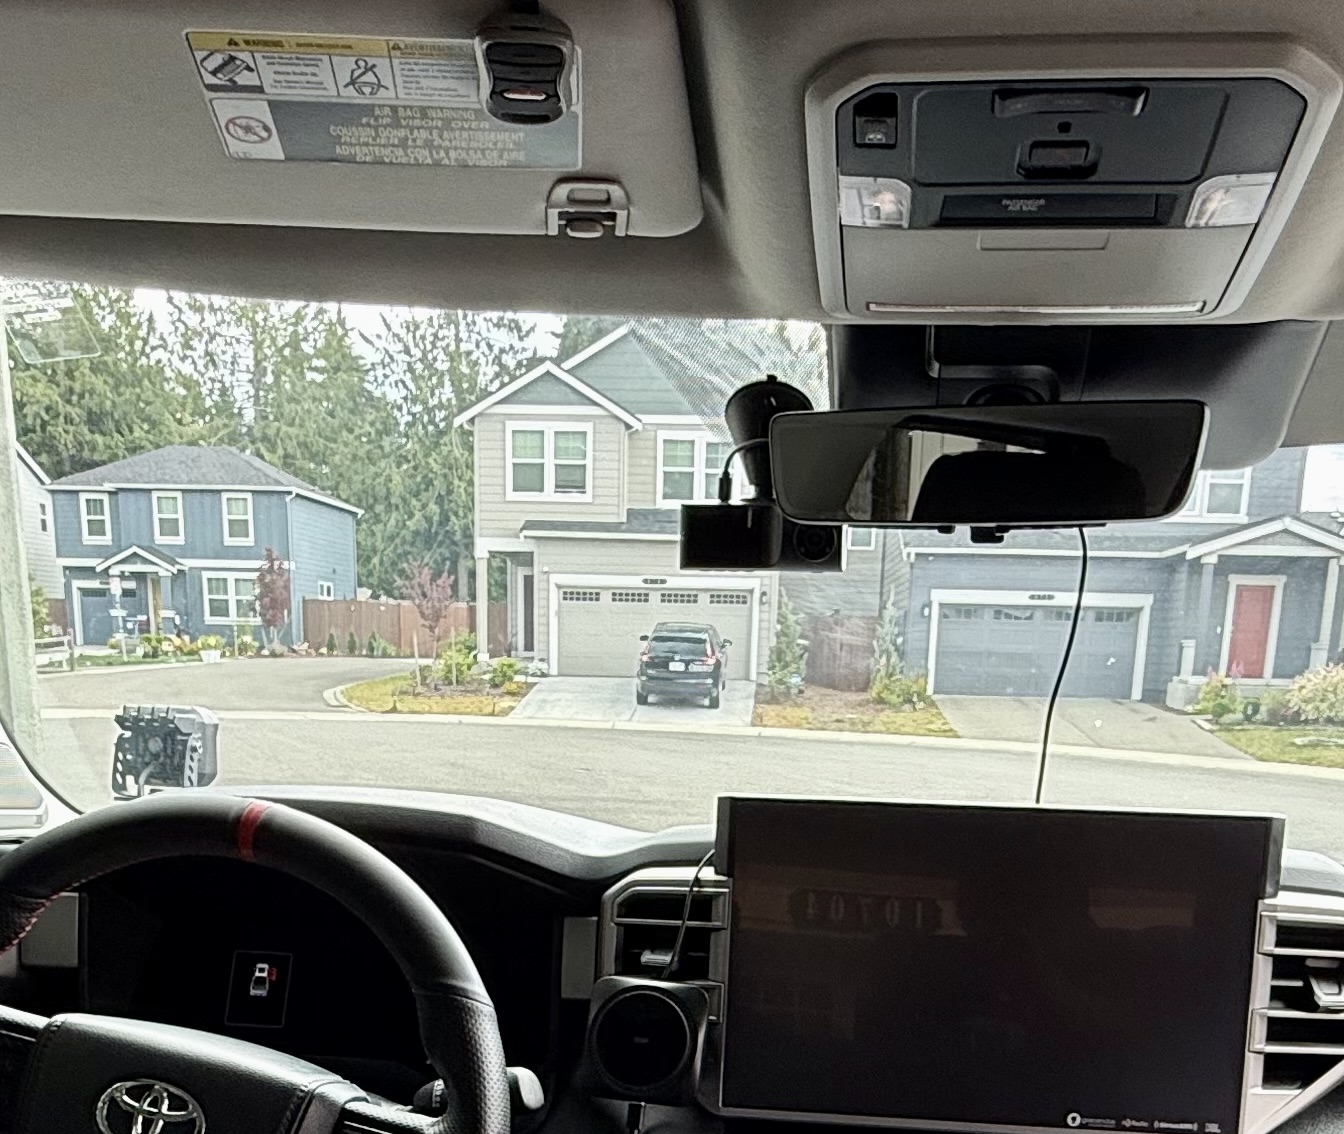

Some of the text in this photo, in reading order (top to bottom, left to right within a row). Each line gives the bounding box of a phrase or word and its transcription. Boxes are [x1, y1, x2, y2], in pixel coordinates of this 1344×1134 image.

[374, 106, 475, 120] AIR BAG WARNING
[361, 116, 491, 130] FLIP VISOR OVER
[330, 124, 376, 137] COUSSIN
[442, 129, 526, 143] AVERTISSEMENT
[407, 147, 430, 158] CON
[433, 148, 447, 159] LA
[485, 150, 498, 161] DE
